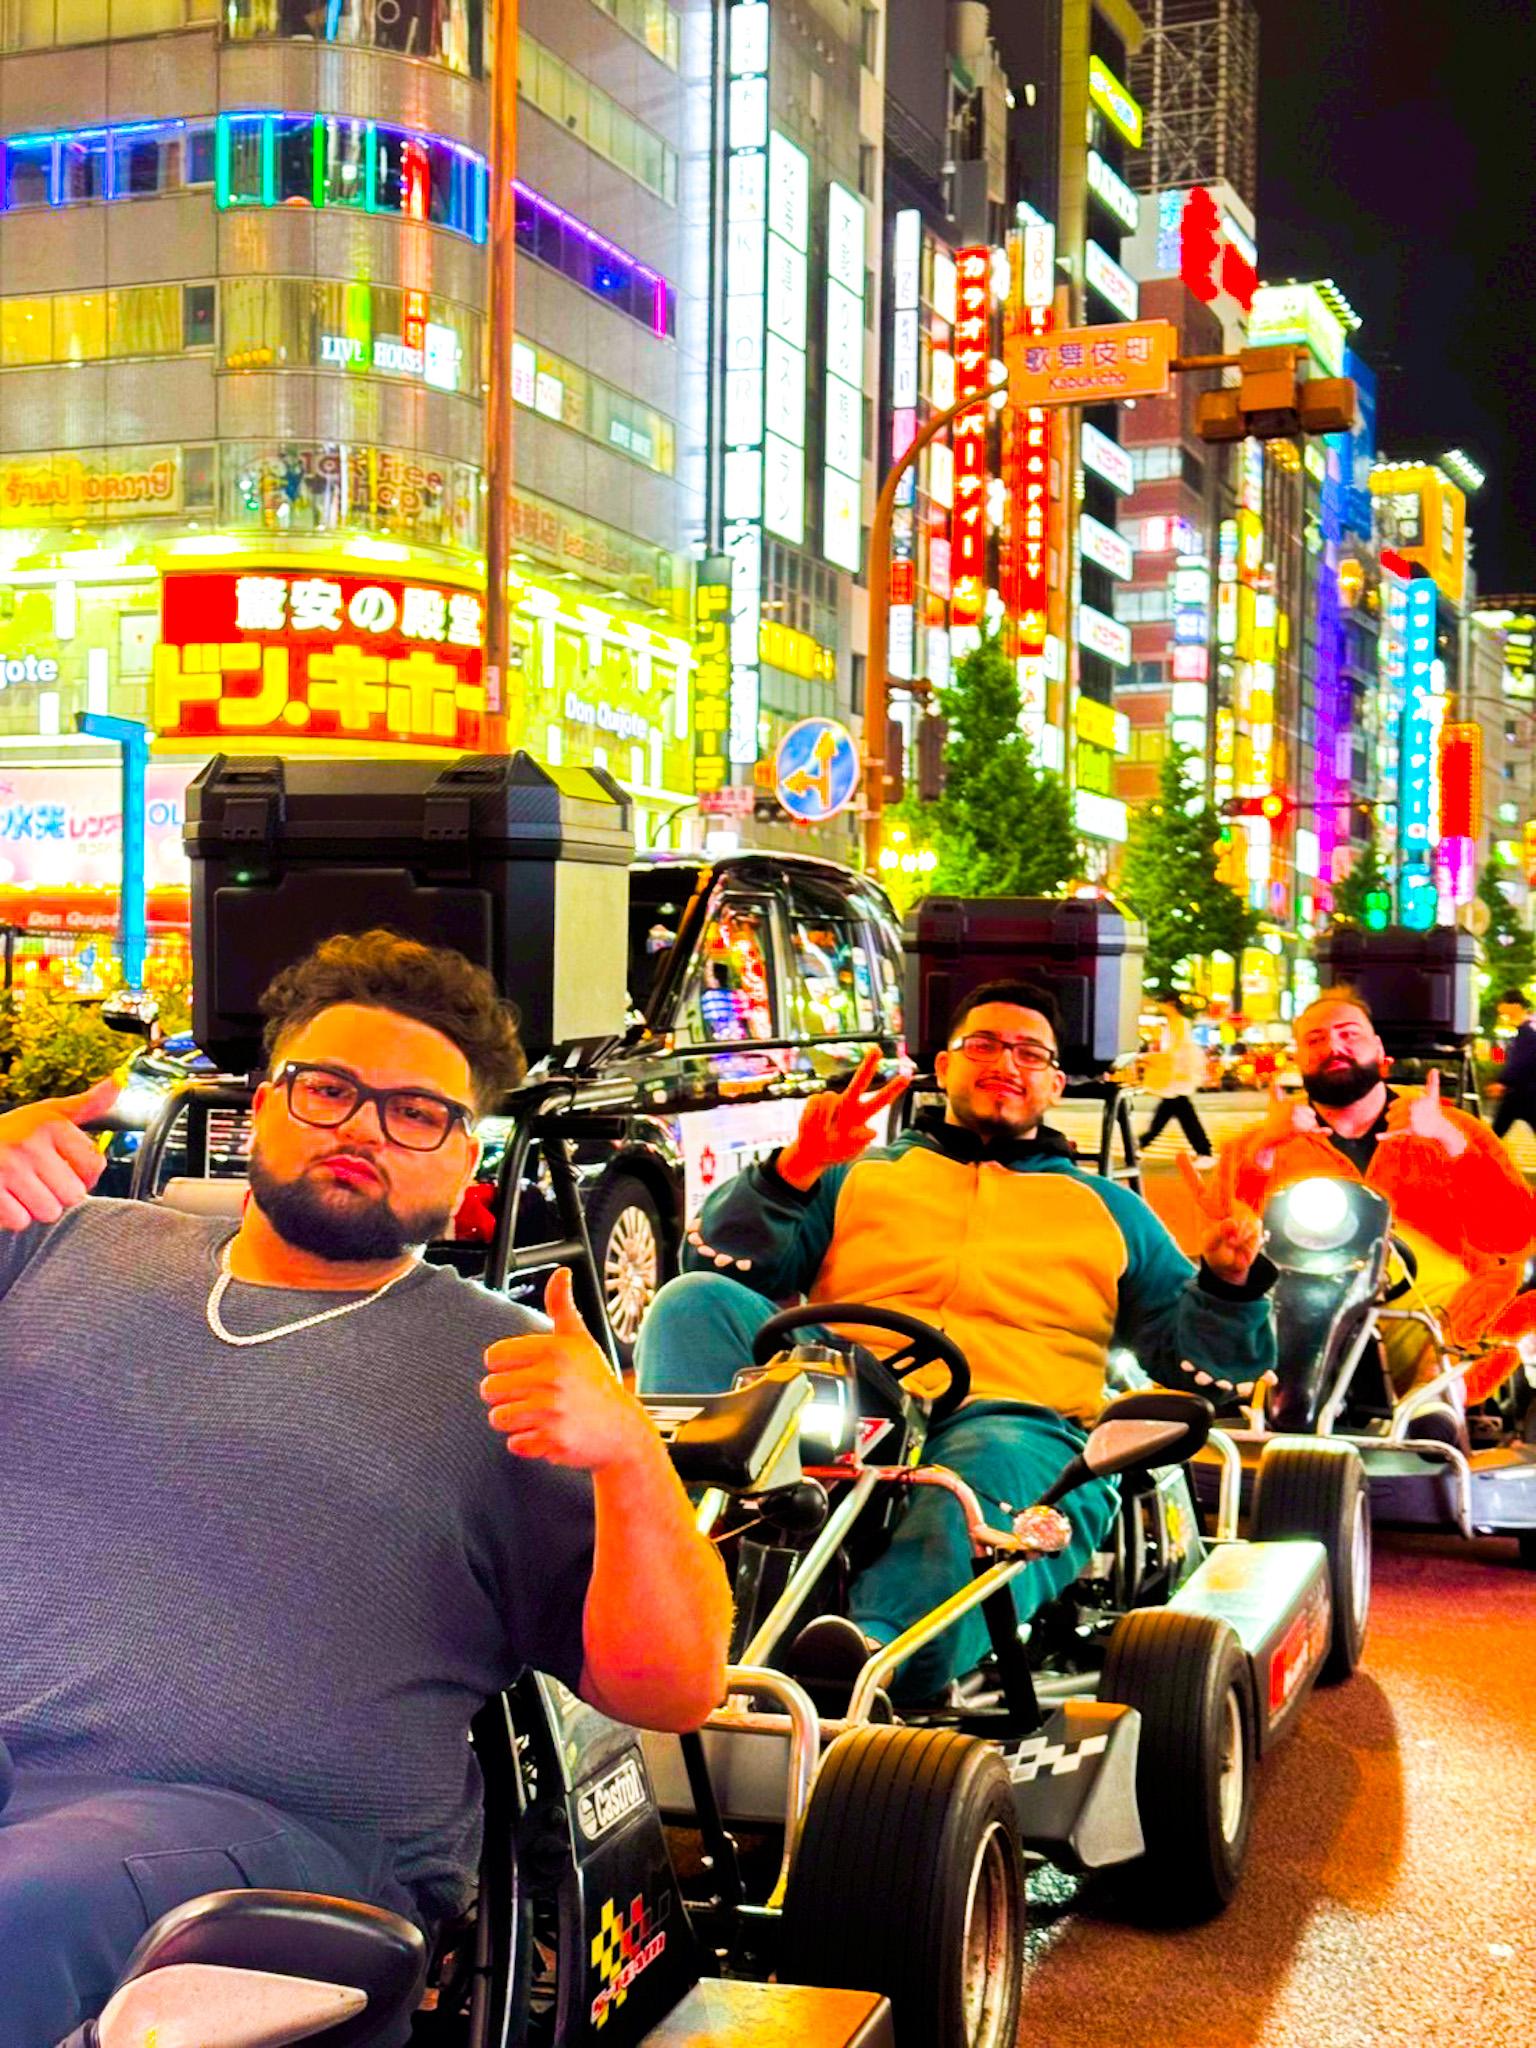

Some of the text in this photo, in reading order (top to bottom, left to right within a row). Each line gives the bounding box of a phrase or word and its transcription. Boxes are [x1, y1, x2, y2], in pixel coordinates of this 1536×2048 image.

[1024, 337, 1152, 373] 歌舞伎町
[1050, 371, 1127, 389] Kabukicho
[6, 459, 176, 507] ร้านปอดภาษี
[378, 453, 444, 493] Free
[1026, 484, 1042, 580] PARTY
[235, 576, 484, 646] 驚安の殿堂
[565, 691, 649, 740] Don Quijote
[28, 911, 120, 929] Don Quijot
[594, 1762, 642, 1827] Castrol
